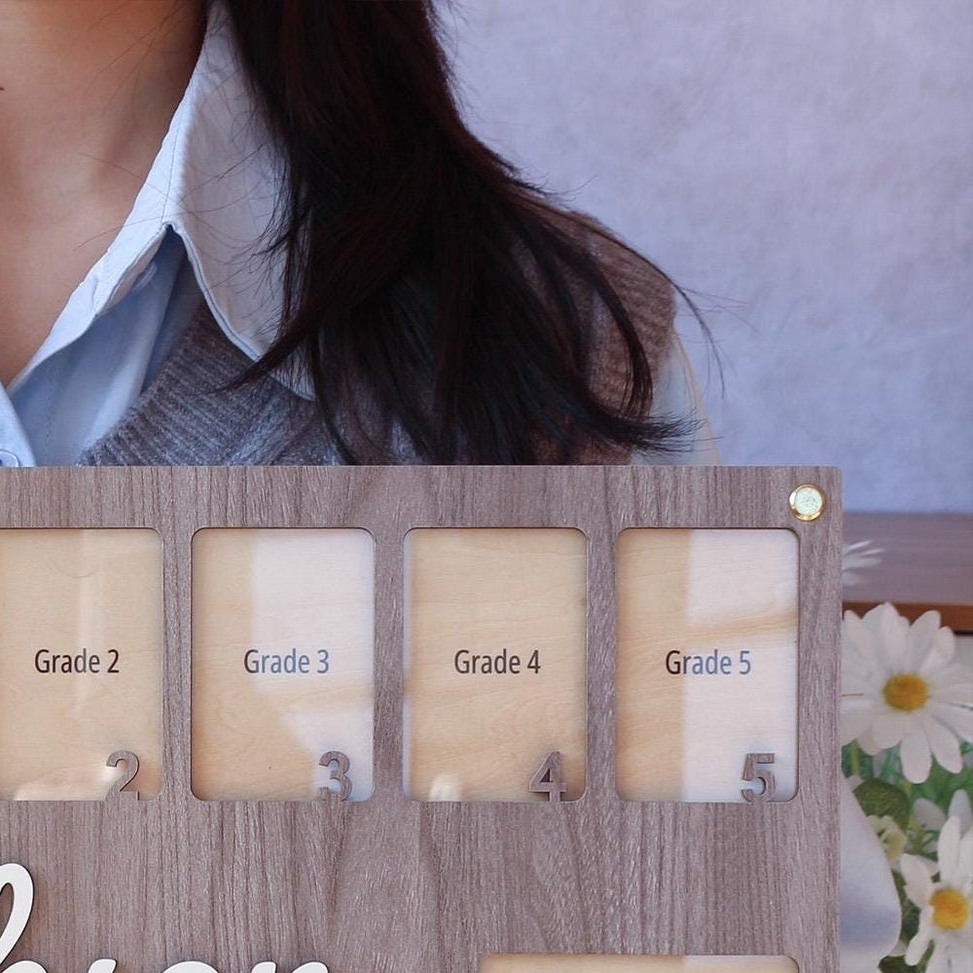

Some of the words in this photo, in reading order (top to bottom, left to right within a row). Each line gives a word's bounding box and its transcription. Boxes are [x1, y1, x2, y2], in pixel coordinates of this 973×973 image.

[34, 648, 101, 675] Grade
[107, 648, 120, 675] 2
[244, 648, 311, 675] Grade
[316, 648, 330, 675] 3
[455, 648, 521, 675] Grade
[526, 648, 541, 675] 4
[665, 648, 733, 675] Grade
[739, 648, 752, 675] 5
[105, 750, 140, 801] 2
[318, 750, 353, 802] 3
[529, 752, 567, 802] 4
[741, 753, 778, 803] 5
